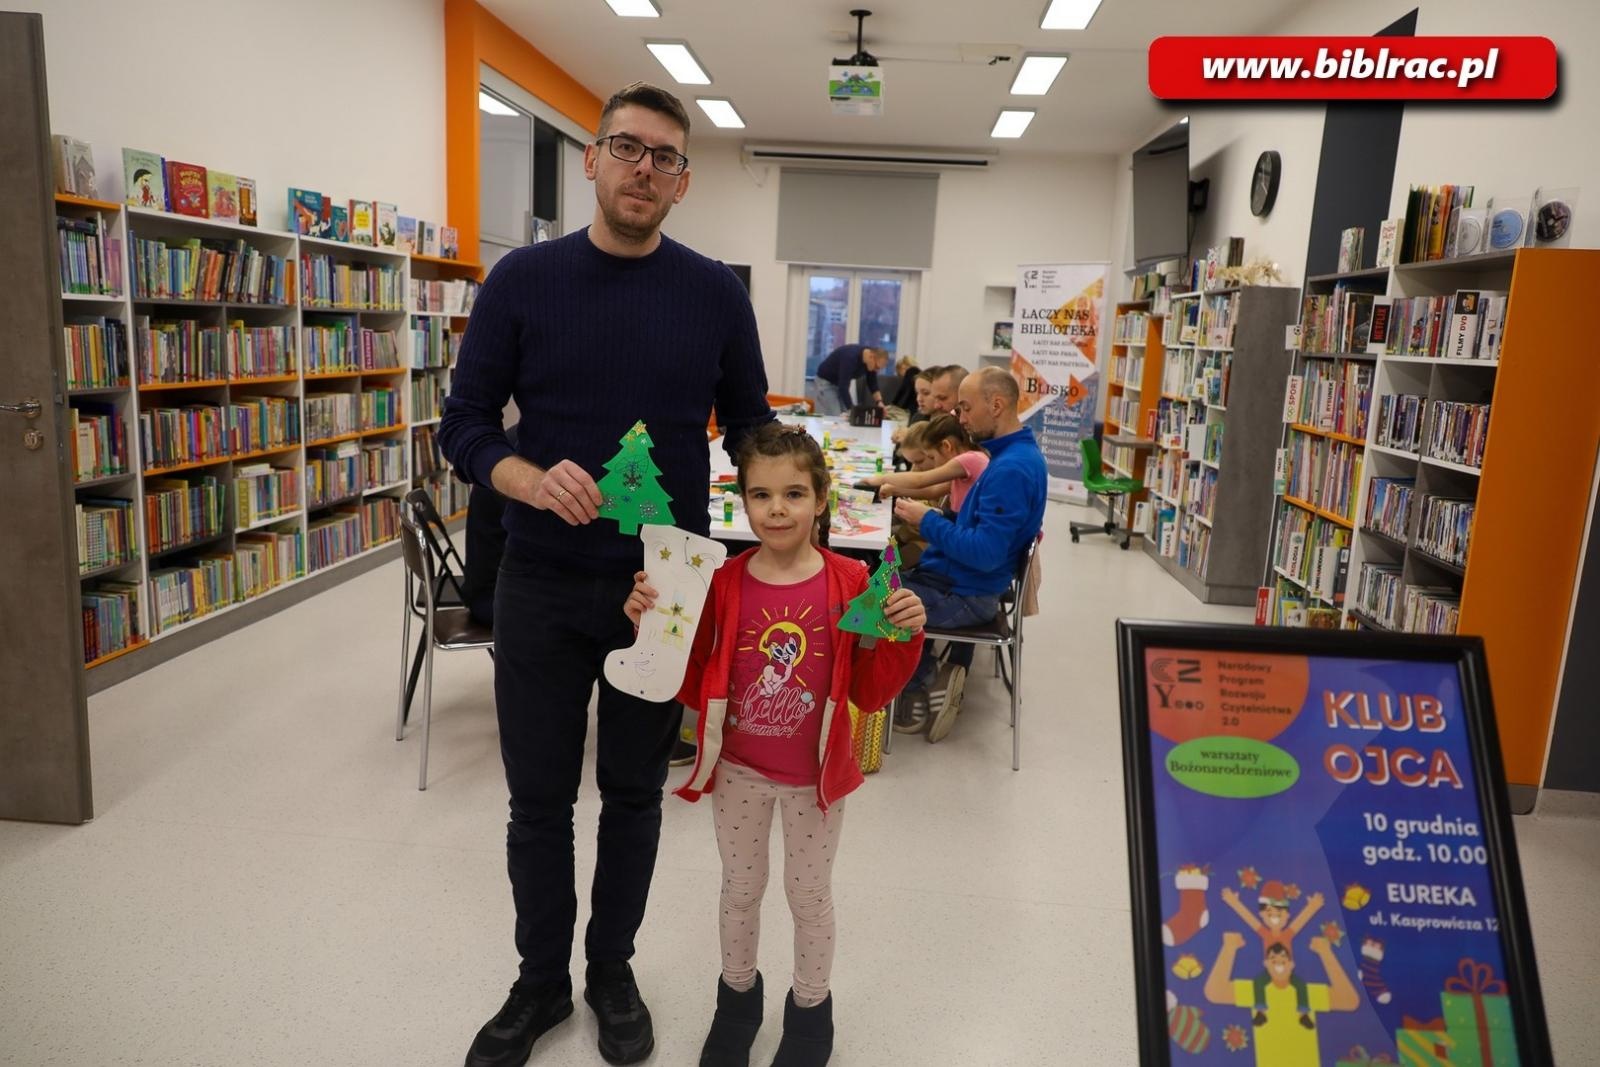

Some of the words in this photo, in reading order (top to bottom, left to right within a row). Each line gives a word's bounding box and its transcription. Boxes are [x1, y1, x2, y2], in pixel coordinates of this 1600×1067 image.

[1064, 309, 1090, 321] NAS
[1460, 315, 1468, 332] DVD
[1021, 324, 1096, 337] BIBLIOTEKA
[1374, 308, 1387, 341] NETFLIX
[1456, 333, 1465, 356] FILMY
[1288, 378, 1298, 406] SPORT
[1290, 545, 1299, 577] EKOLOGIA
[1218, 661, 1272, 673] Narodowy
[1219, 675, 1265, 686] Program
[1220, 689, 1266, 701] Rozwoju
[1221, 703, 1292, 715] Czytelnictwa
[1323, 690, 1447, 733] KLUB
[1222, 717, 1240, 727] 2.0
[1201, 751, 1260, 763] warsztaty
[1170, 761, 1293, 778] Bożonarodzeniowe
[1323, 744, 1464, 790] OJCA
[1363, 813, 1388, 832] 10
[1394, 815, 1480, 840] grudnia
[1363, 841, 1422, 865] godz.
[1427, 844, 1488, 866] 10.00
[1387, 884, 1477, 907] EUREKA
[1369, 912, 1388, 926] ul.
[1391, 915, 1483, 932] Kasprowicza
